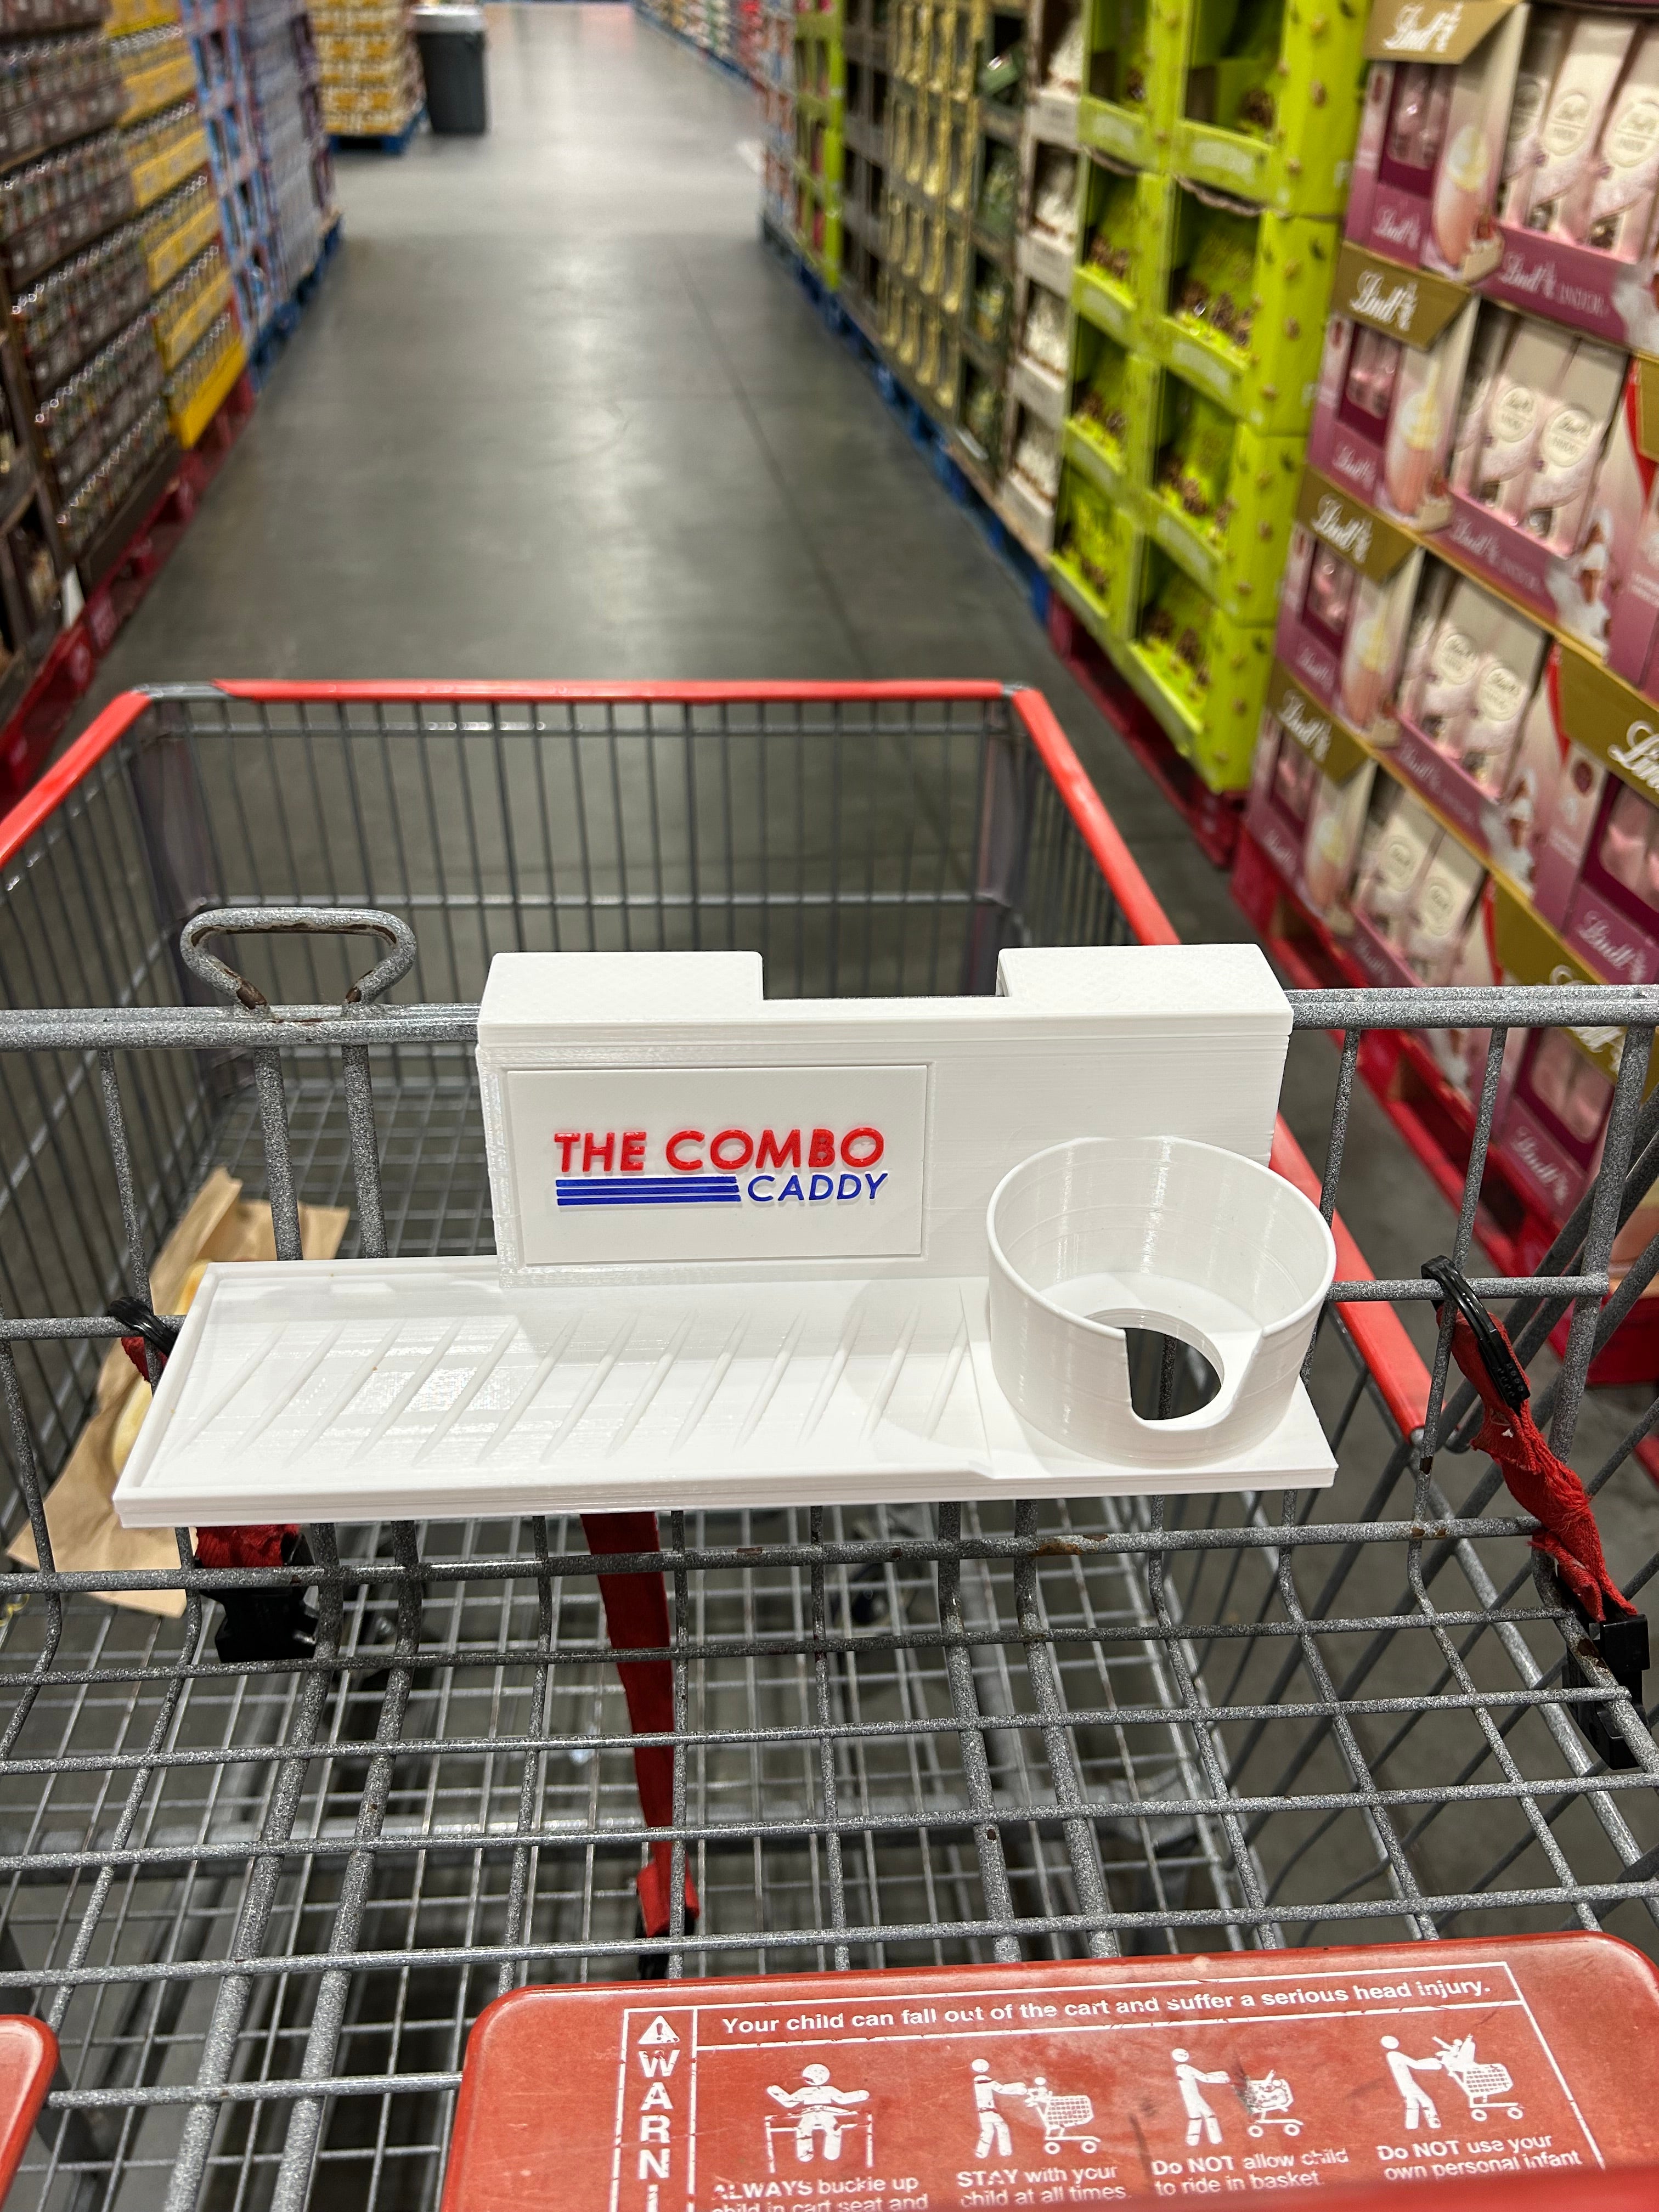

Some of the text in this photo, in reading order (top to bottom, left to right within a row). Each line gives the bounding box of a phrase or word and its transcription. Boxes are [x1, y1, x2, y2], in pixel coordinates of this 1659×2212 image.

[554, 1126, 885, 1172] THE COMBO
[747, 1173, 889, 1202] CADDY
[722, 1979, 1492, 2034] Your child can fall out of the cart and suffer a serious head injury.
[1375, 2136, 1552, 2159] Do NOT use your
[1152, 2148, 1349, 2175] Do NOT allow child
[1384, 2151, 1583, 2180] own personal infant
[714, 2181, 813, 2199] ALWAYS
[893, 2177, 919, 2192] up
[957, 2166, 1118, 2187] STAY with your
[1155, 2180, 1176, 2196] to
[1182, 2176, 1221, 2193] ride
[1226, 2176, 1245, 2191] in
[838, 2198, 883, 2212] seat
[889, 2193, 929, 2211] and
[961, 2189, 1008, 2207] child
[1015, 2188, 1035, 2204] at
[1042, 2186, 1064, 2204] all
